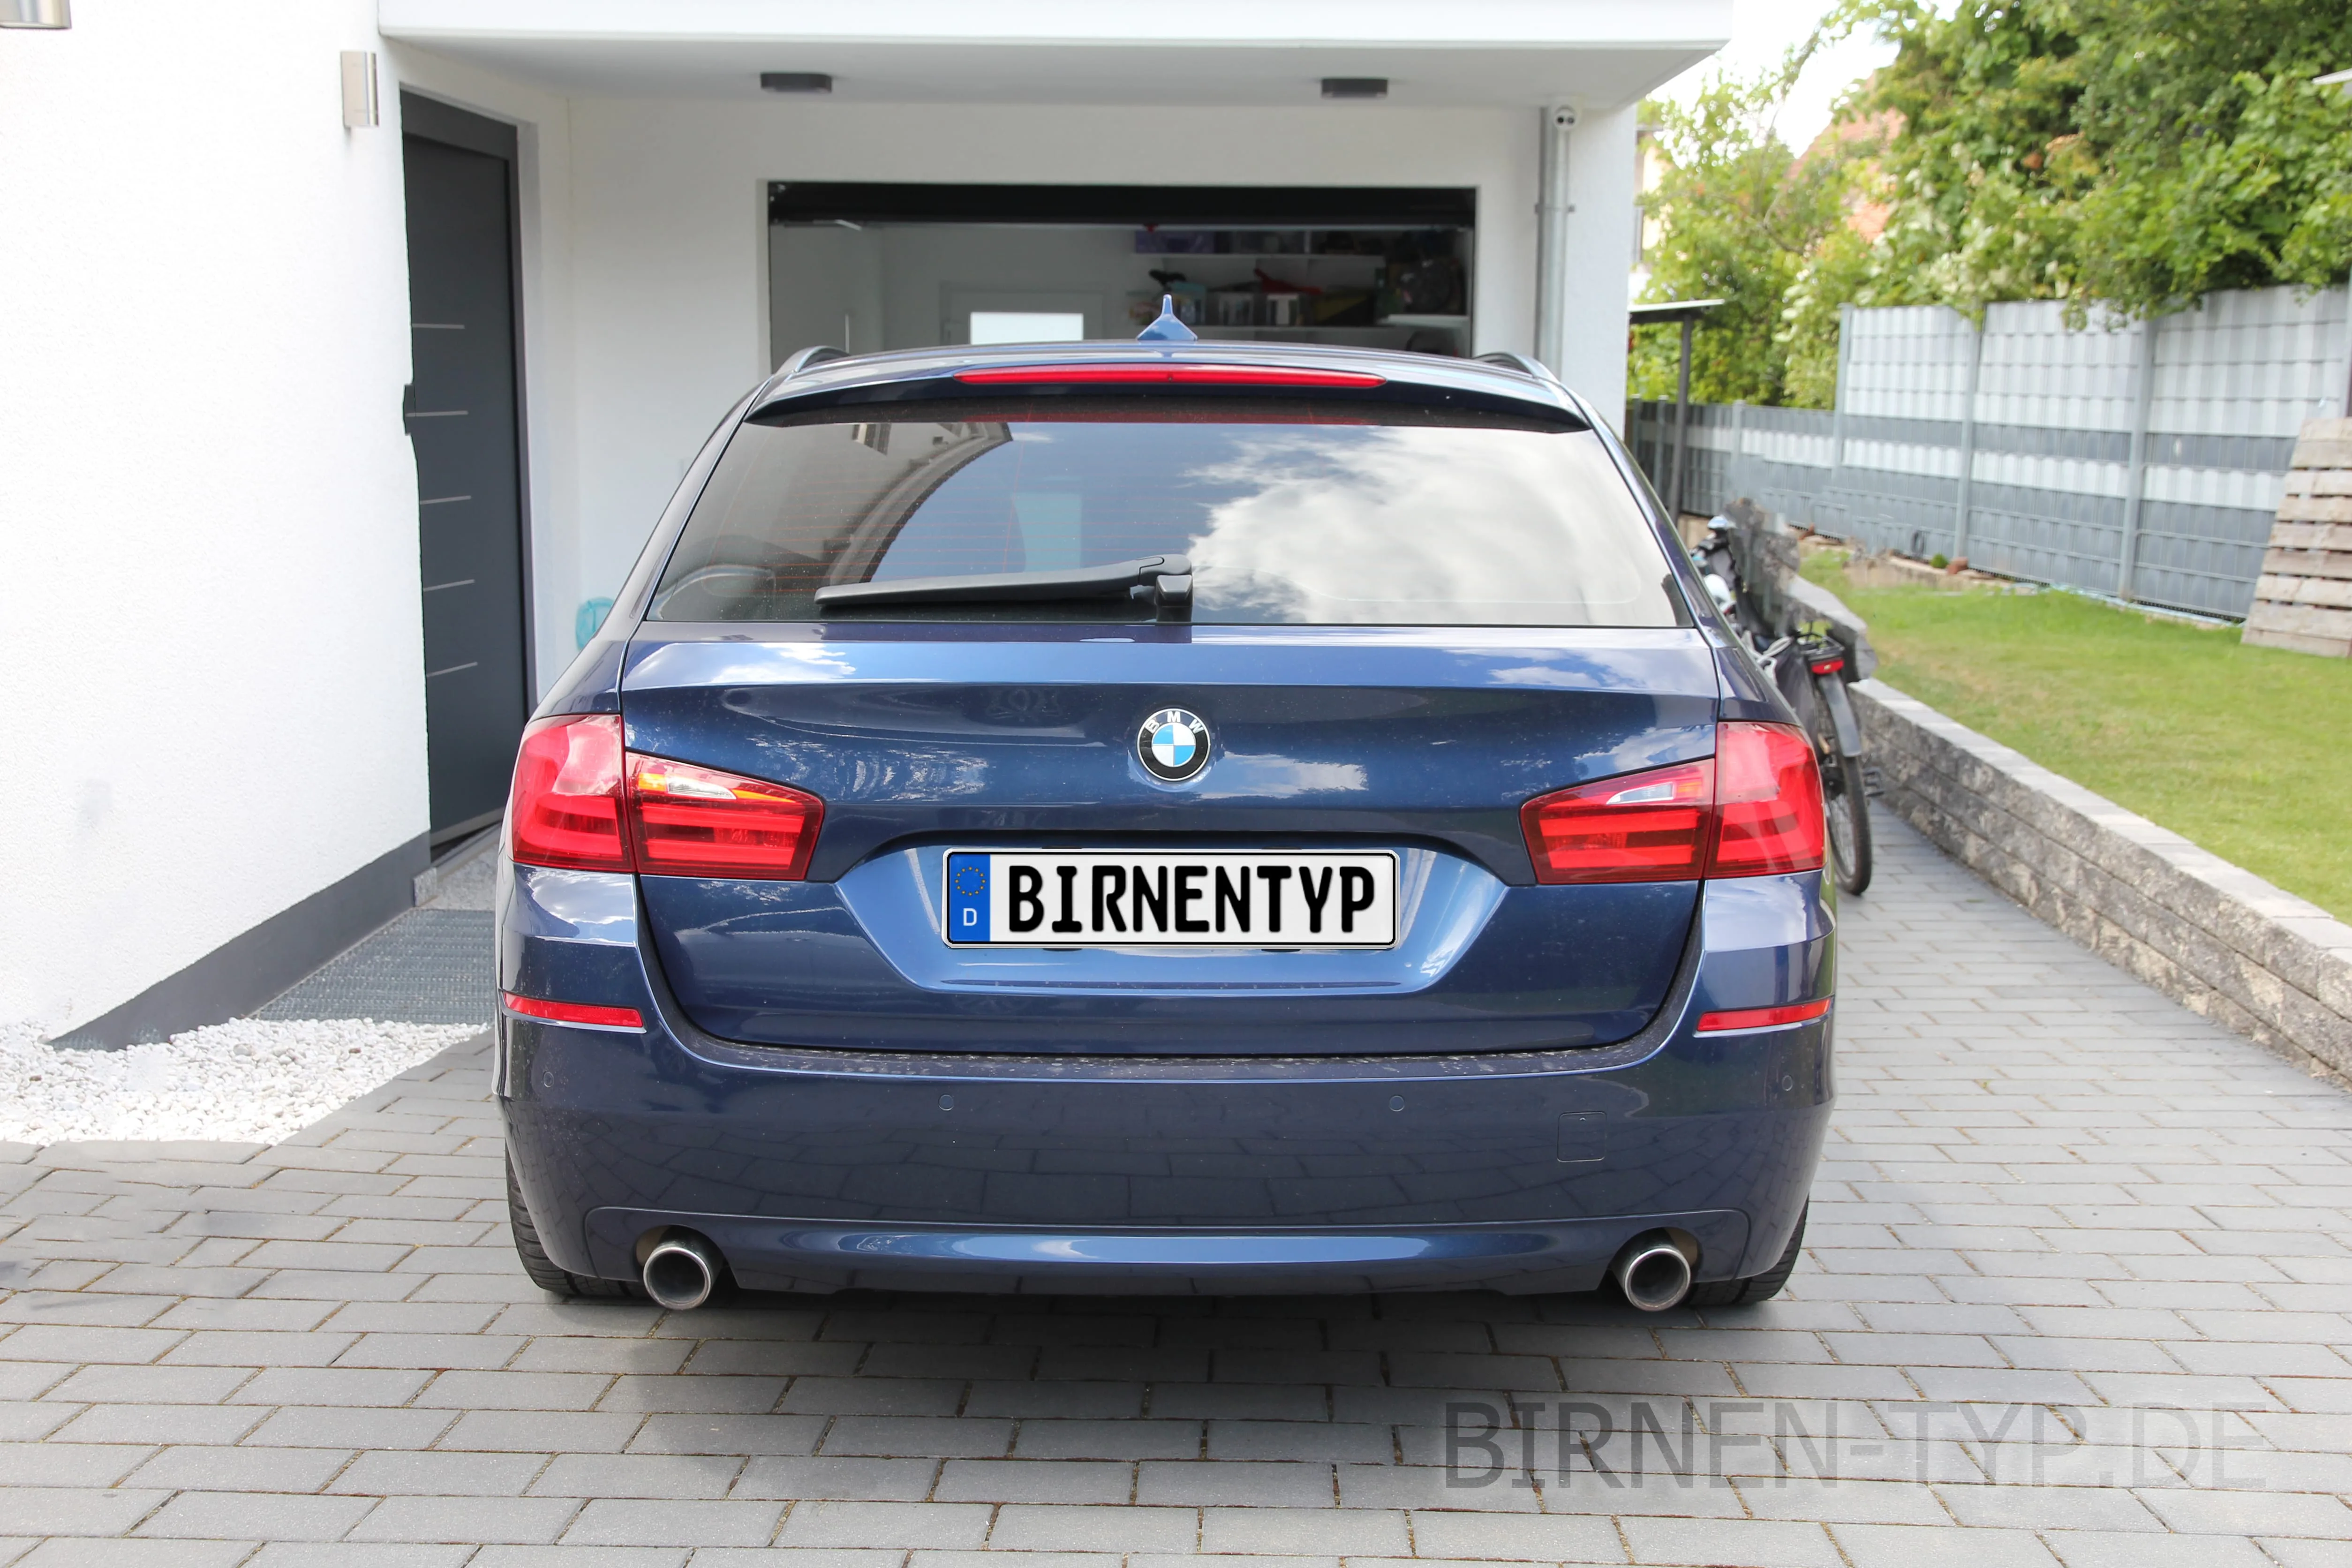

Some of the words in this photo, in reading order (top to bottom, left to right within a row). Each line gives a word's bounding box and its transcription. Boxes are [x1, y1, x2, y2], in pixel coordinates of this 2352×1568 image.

[1145, 711, 1204, 734] BMW
[1009, 865, 1374, 933] BIRNENTYP
[963, 908, 977, 926] D
